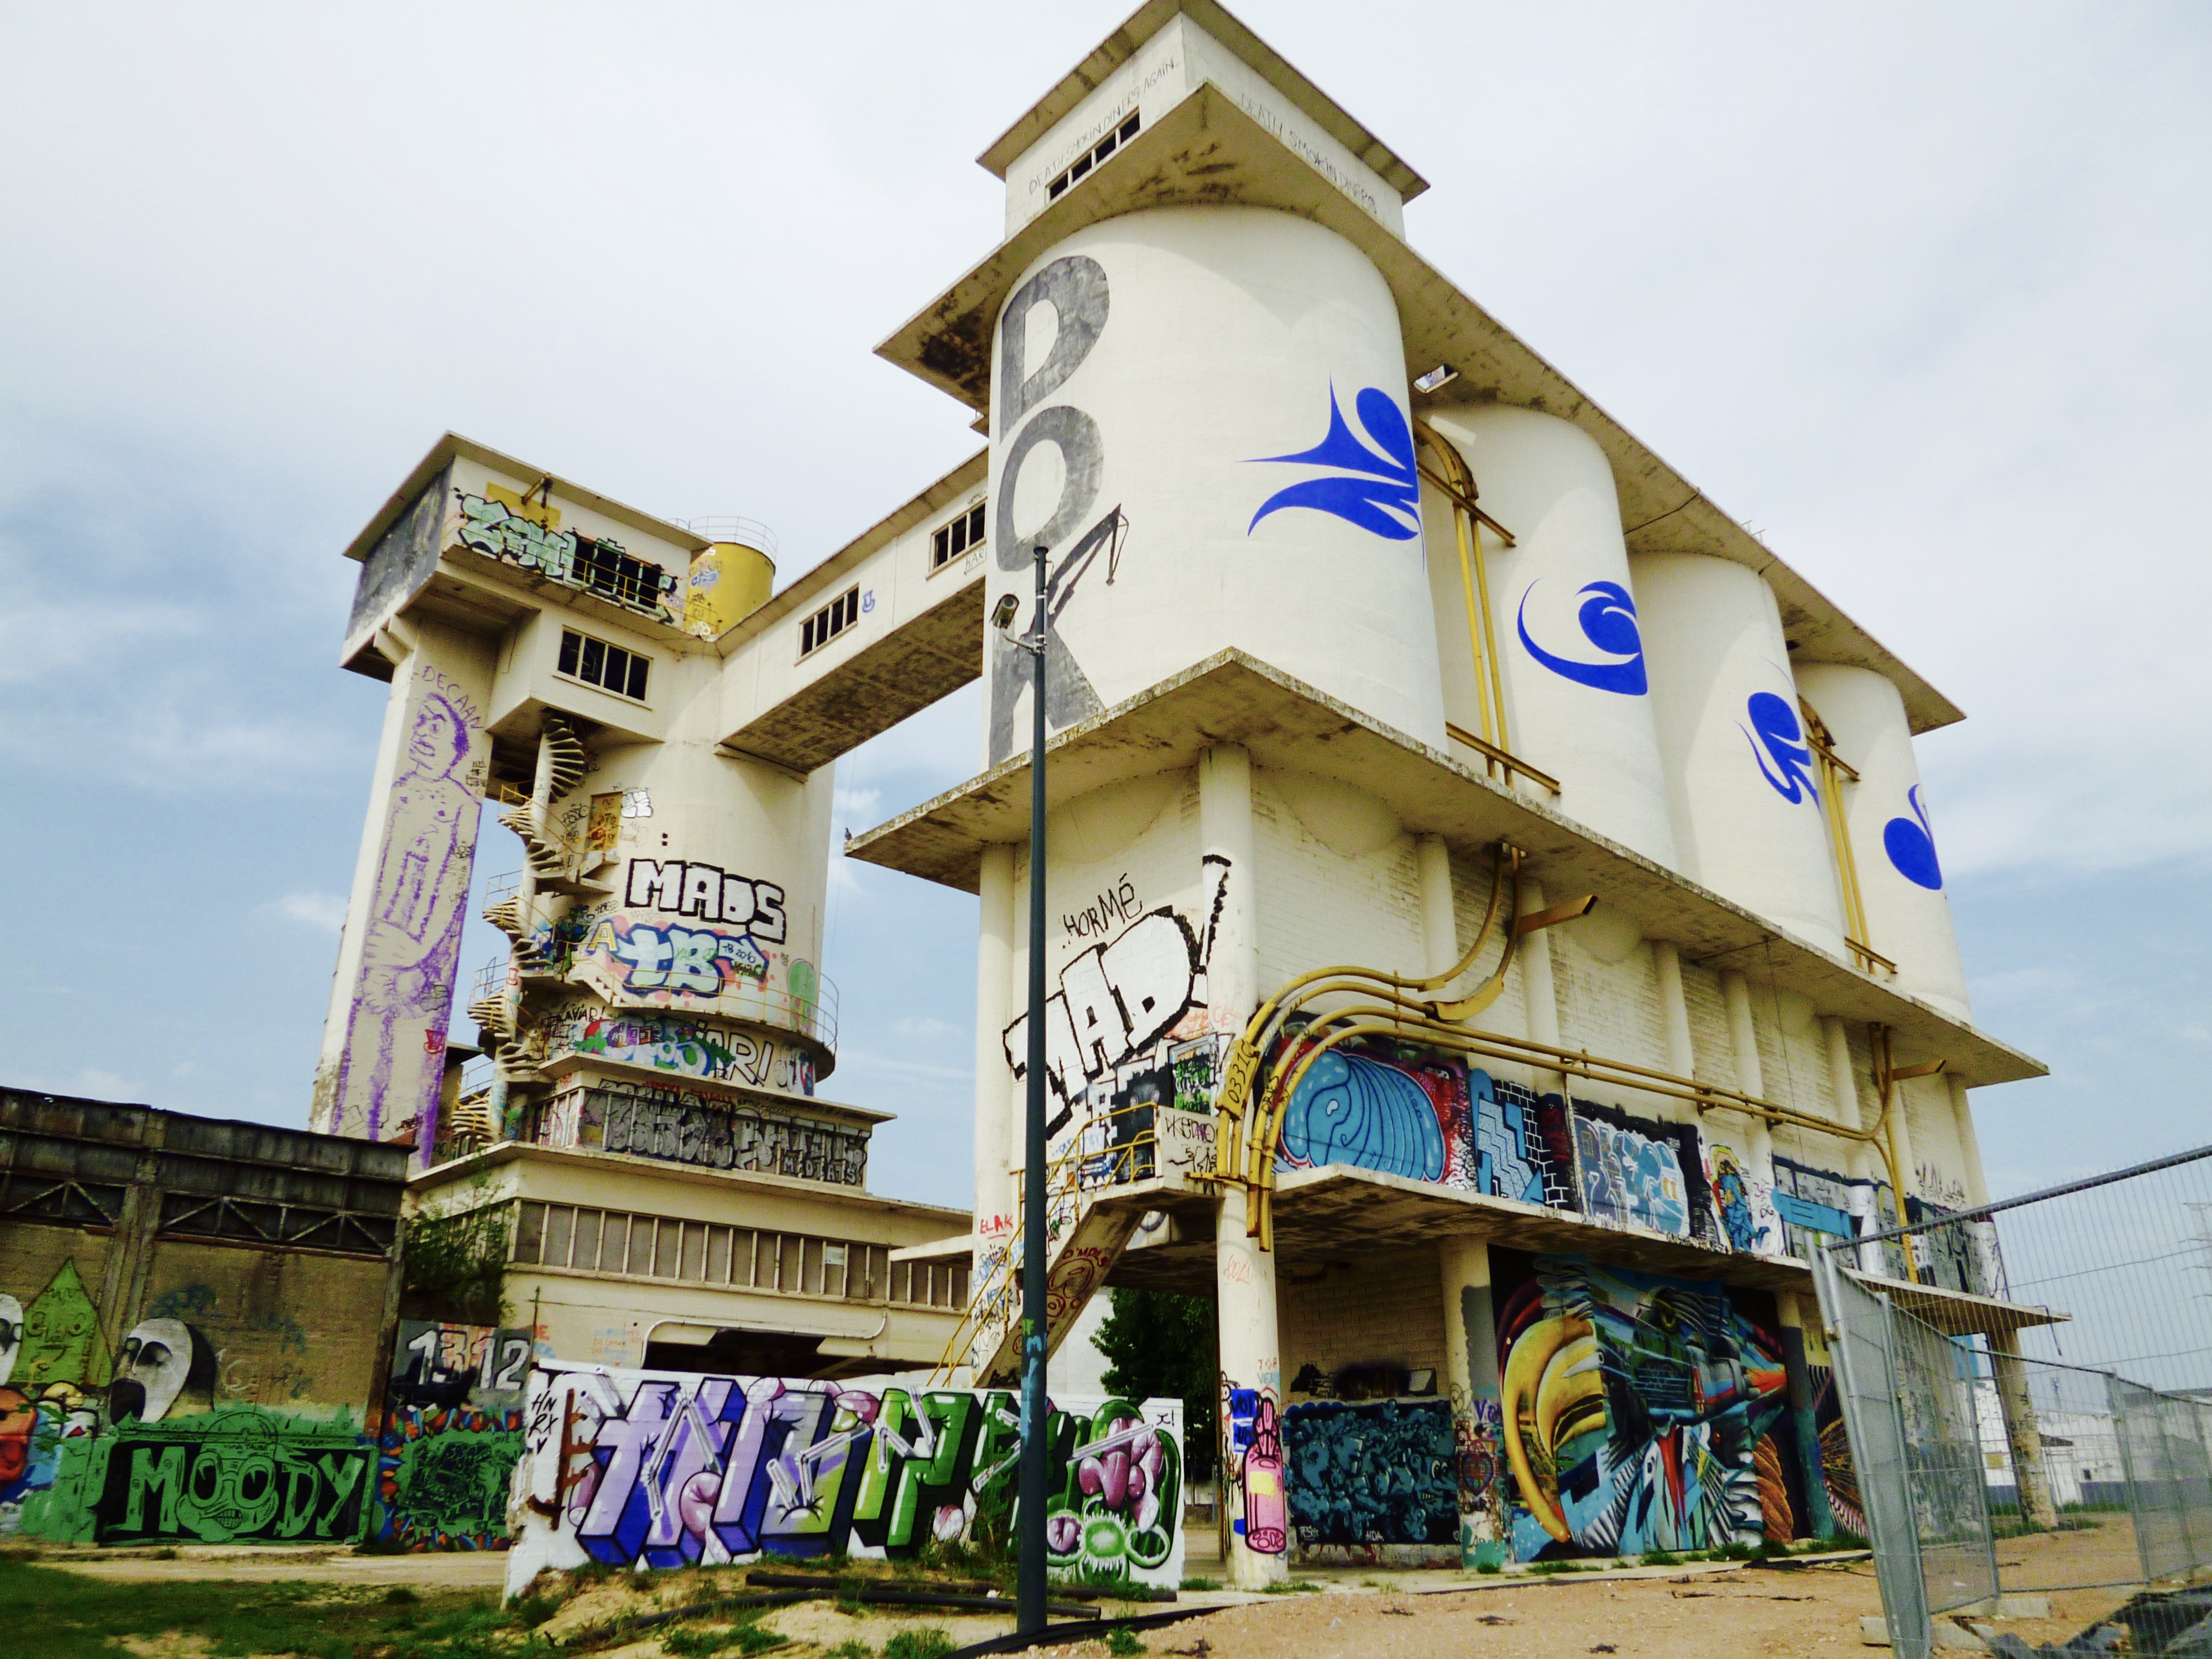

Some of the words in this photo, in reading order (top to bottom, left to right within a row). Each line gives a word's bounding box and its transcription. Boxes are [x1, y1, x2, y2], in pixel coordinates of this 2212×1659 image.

[624, 858, 786, 944] MADS
[408, 1329, 529, 1391] 1312
[105, 1444, 364, 1538] MOODY
